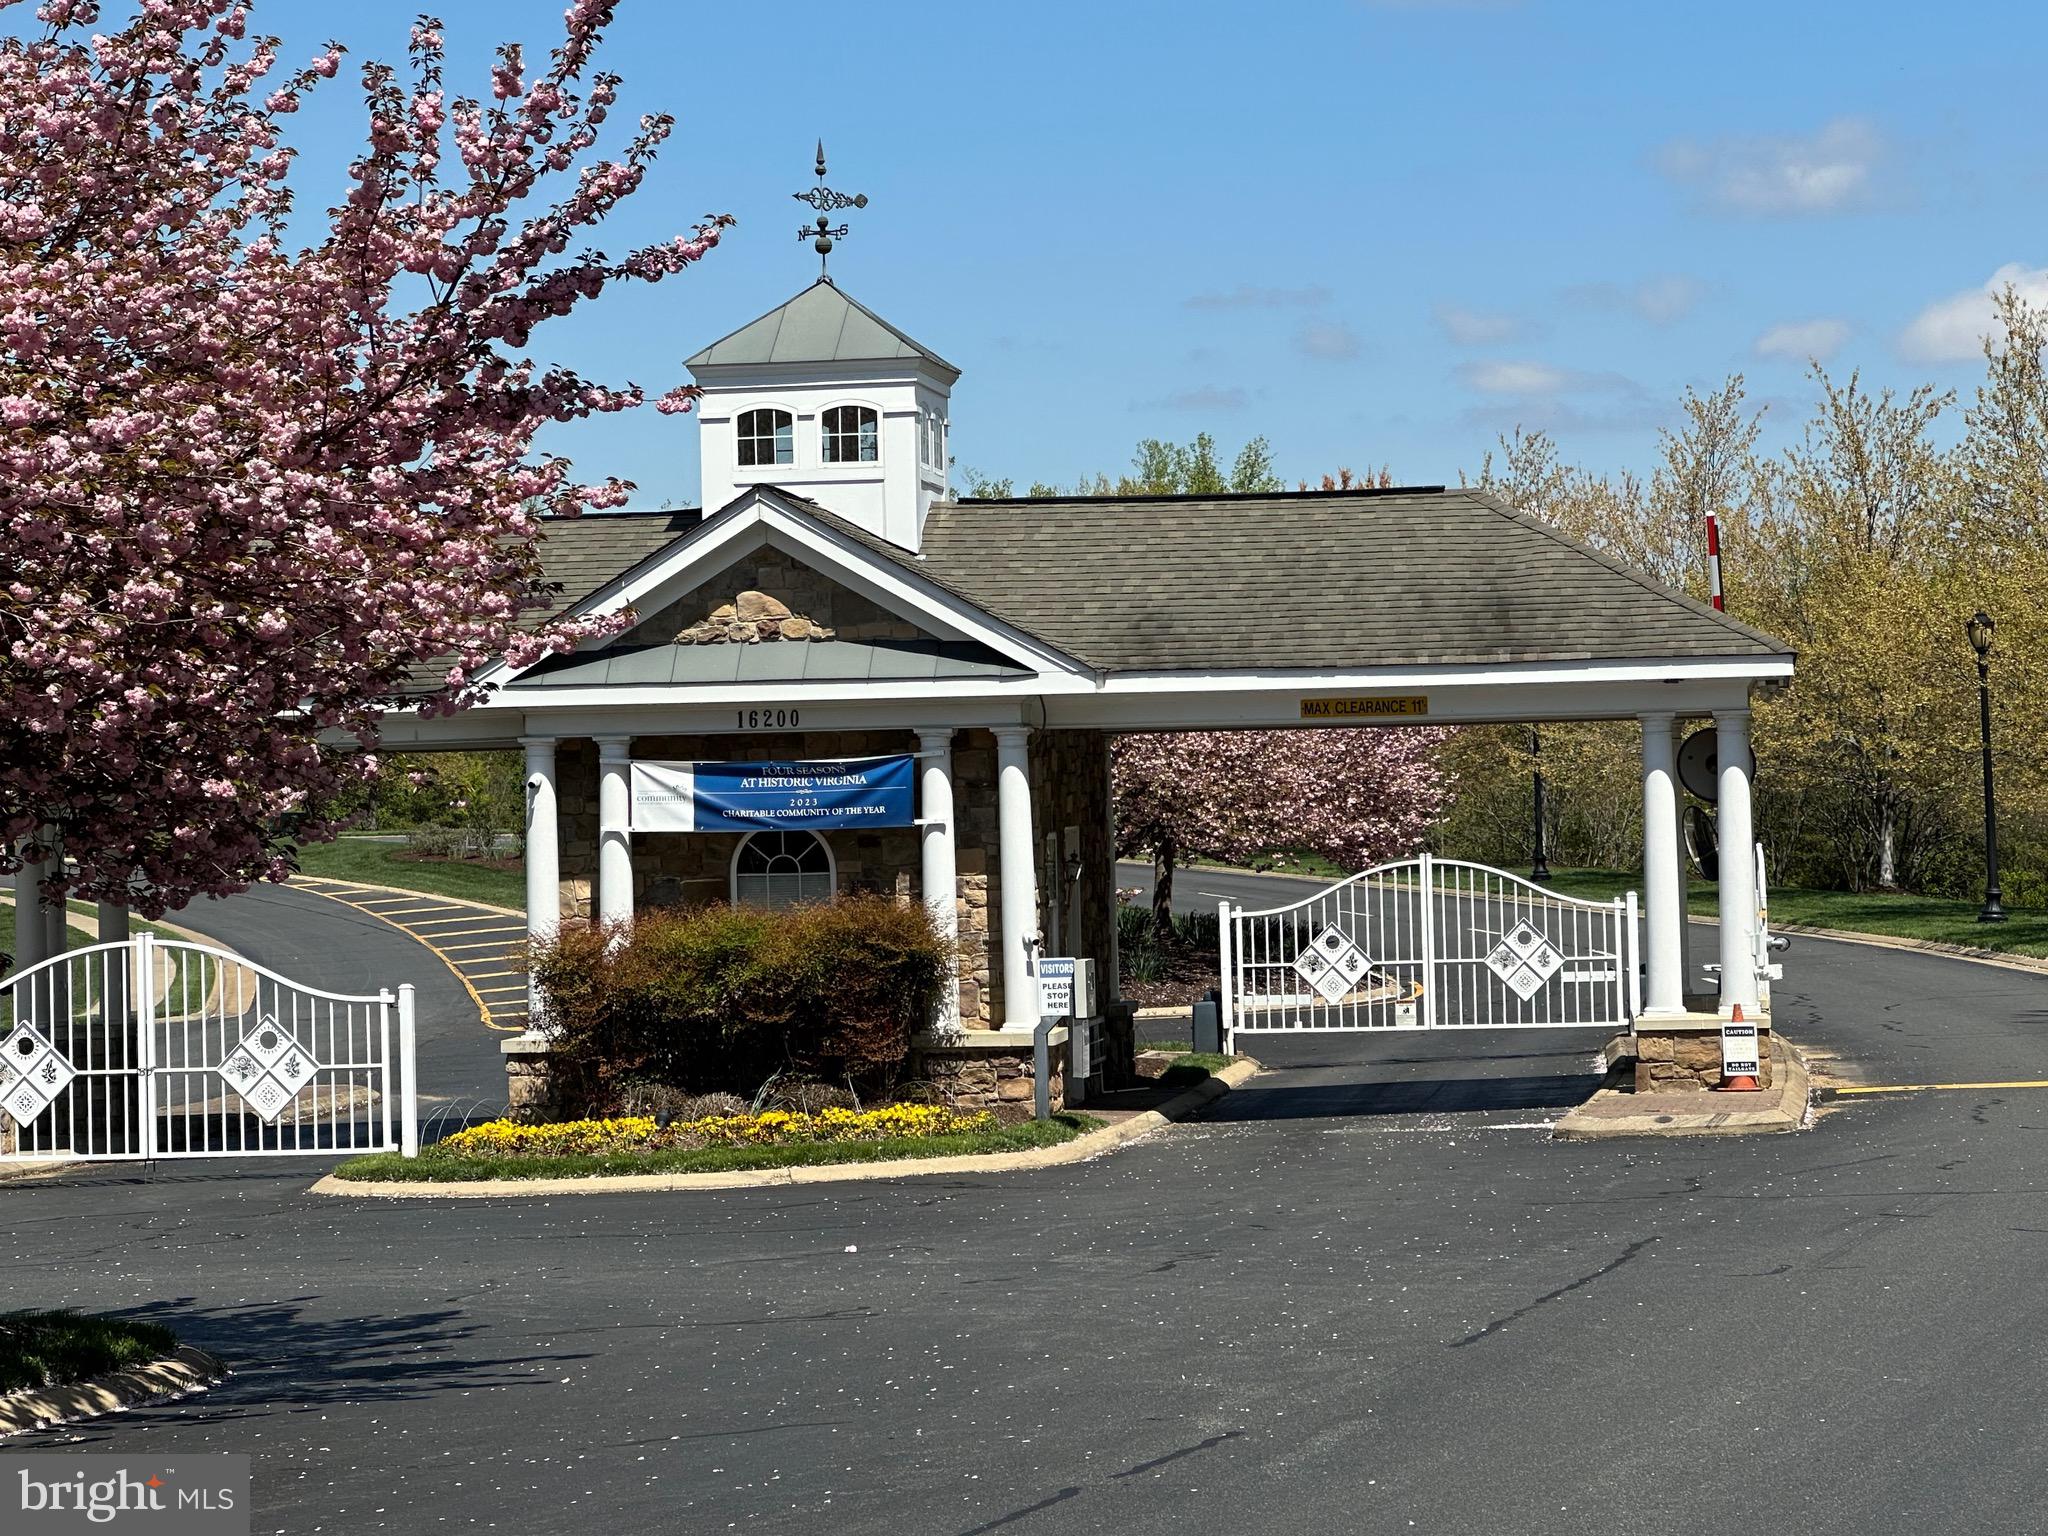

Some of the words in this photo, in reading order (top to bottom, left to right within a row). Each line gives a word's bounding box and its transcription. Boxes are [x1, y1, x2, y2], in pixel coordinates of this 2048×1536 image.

[1304, 702, 1330, 715] MAX
[1335, 700, 1406, 713] CLEARANCE
[737, 709, 799, 728] 16200
[762, 766, 794, 775] FOUR
[796, 765, 846, 774] SEASONS
[741, 777, 757, 788] AT
[758, 777, 813, 788] HISTORIC
[816, 775, 867, 786] VIRGINIA
[637, 794, 687, 803] community
[790, 798, 818, 807] 2023
[722, 809, 775, 818] CHARITABLE
[776, 808, 830, 817] COMMUNITY
[832, 807, 844, 815] OF
[863, 806, 886, 814] YEAR
[1041, 964, 1073, 974] VISITORS
